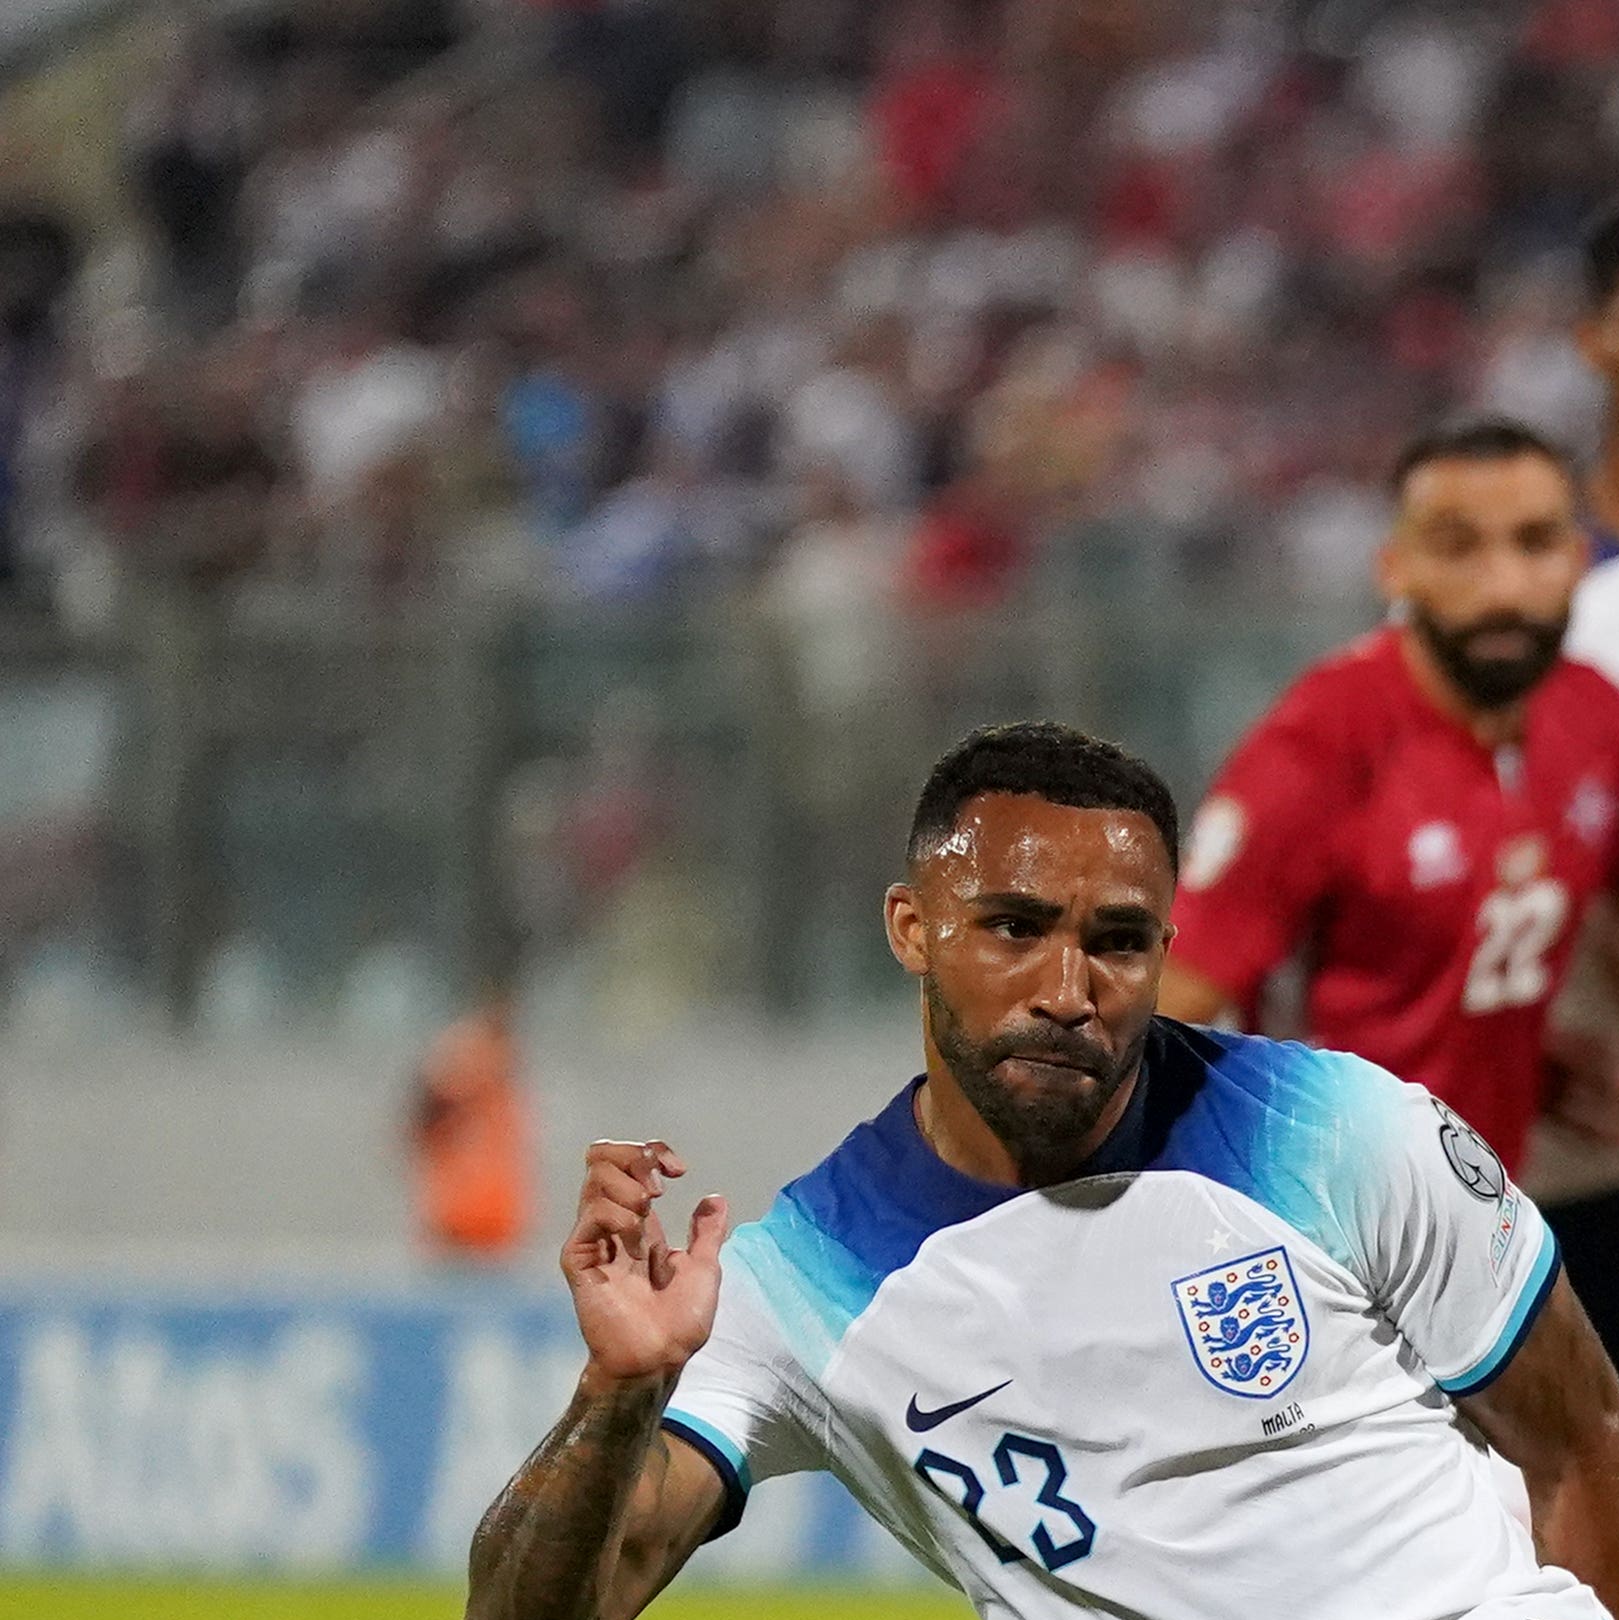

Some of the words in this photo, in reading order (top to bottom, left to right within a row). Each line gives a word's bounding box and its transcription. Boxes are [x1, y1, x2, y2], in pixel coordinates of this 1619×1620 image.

[1462, 878, 1571, 1017] 22
[1260, 1401, 1305, 1437] MALTA
[914, 1432, 1098, 1574] 23
